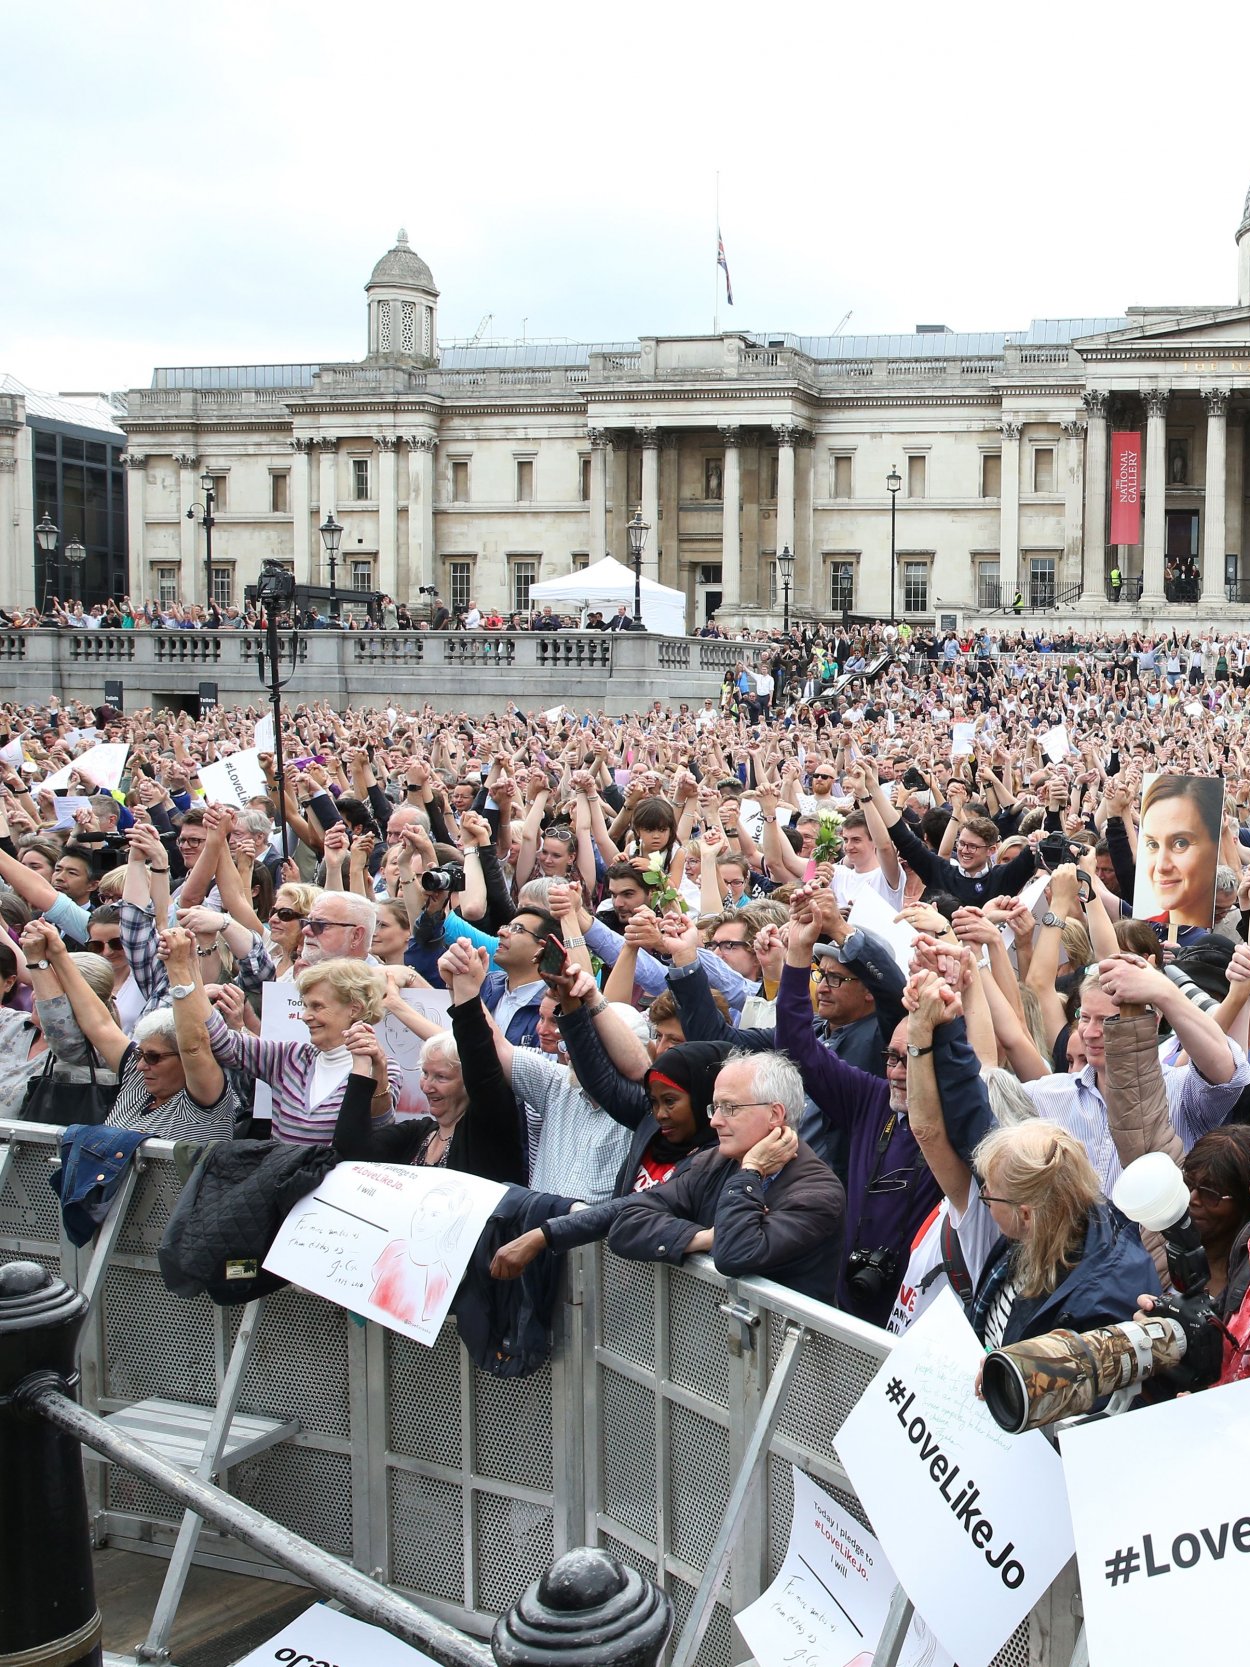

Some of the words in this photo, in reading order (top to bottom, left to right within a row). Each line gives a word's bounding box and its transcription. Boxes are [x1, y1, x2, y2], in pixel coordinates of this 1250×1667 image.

[1183, 362, 1217, 372] THE
[1120, 451, 1128, 503] NATIONAL
[1128, 451, 1137, 503] GALLERY
[225, 762, 251, 806] #LoveLik
[361, 1186, 377, 1198] will
[885, 1376, 1025, 1590] #LoveLikeJo
[813, 1501, 835, 1528] Today
[836, 1522, 840, 1531] I
[840, 1528, 865, 1557] pledge
[865, 1553, 875, 1567] to
[814, 1520, 869, 1582] #LoveLikeJo.
[830, 1554, 834, 1563] I
[834, 1559, 849, 1579] will
